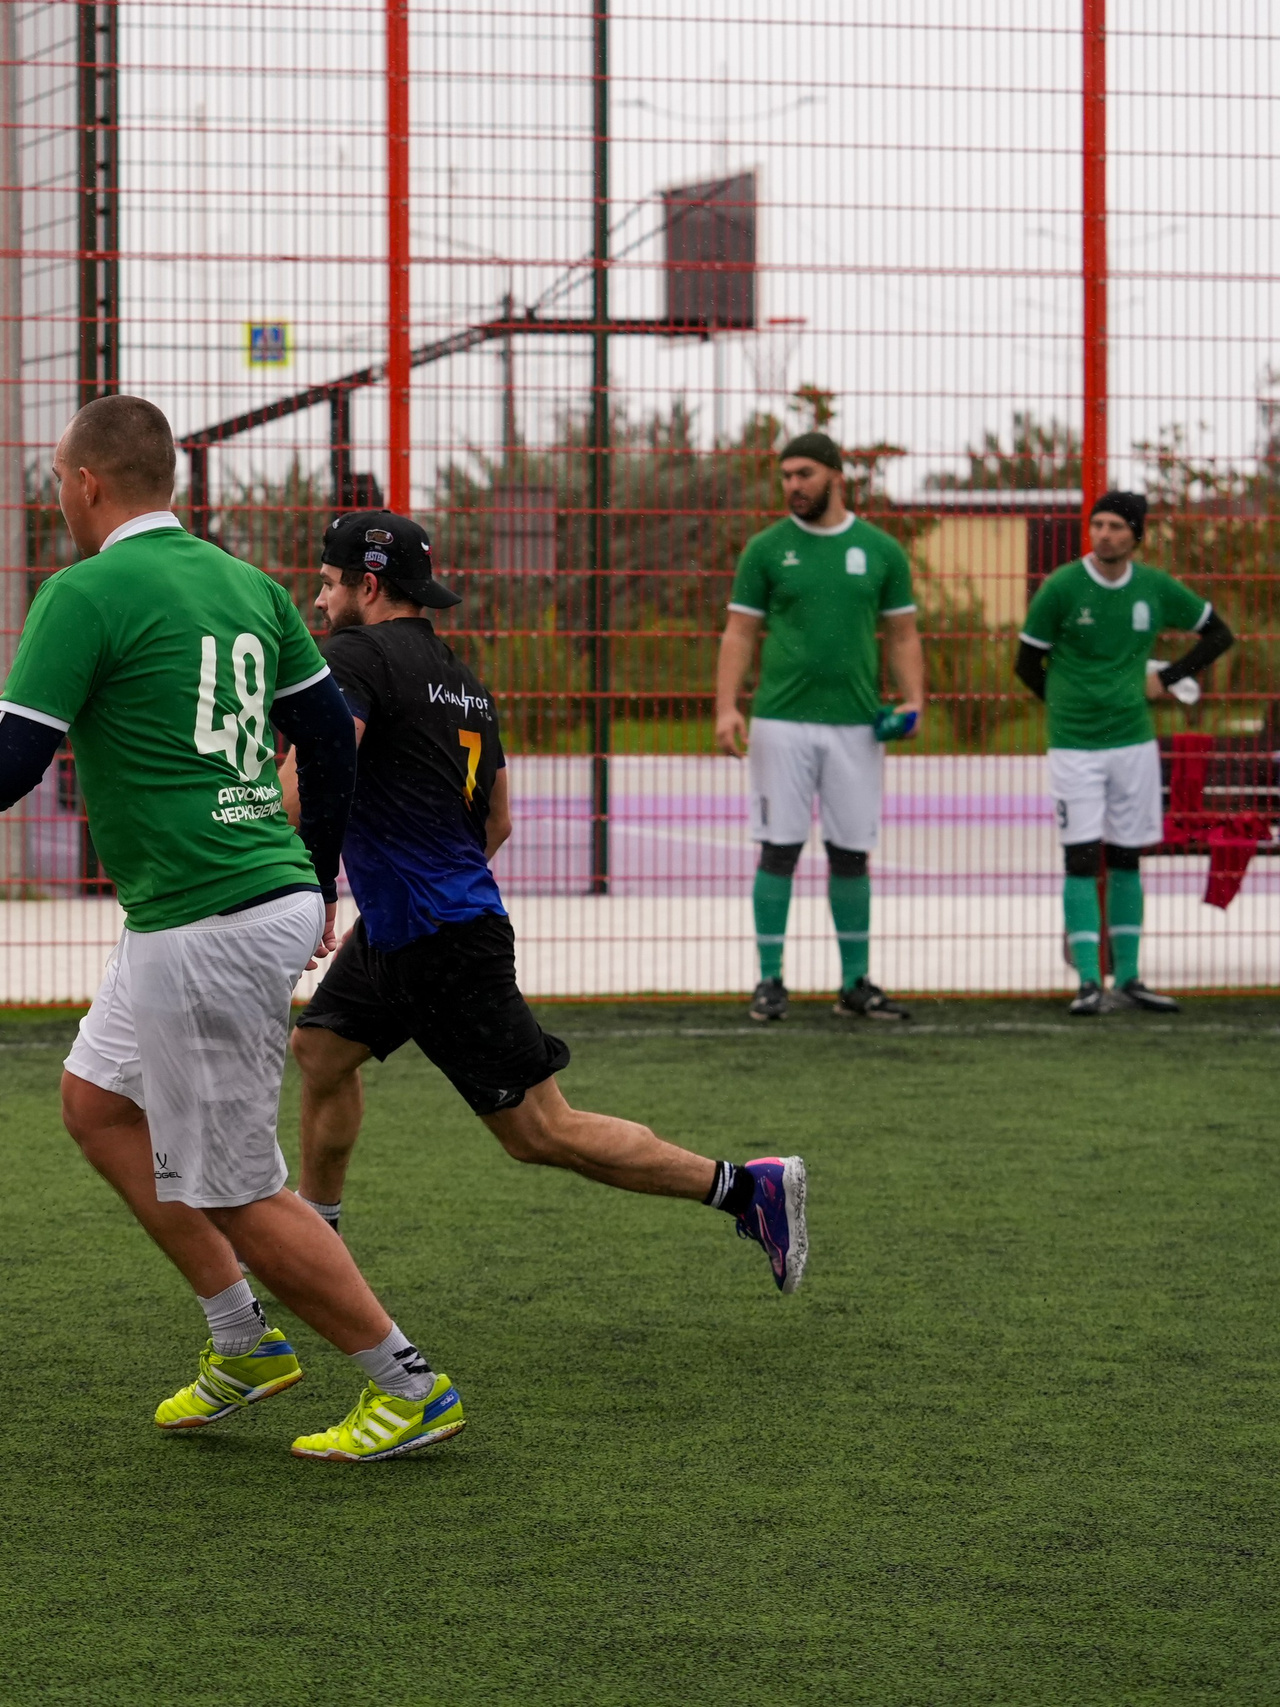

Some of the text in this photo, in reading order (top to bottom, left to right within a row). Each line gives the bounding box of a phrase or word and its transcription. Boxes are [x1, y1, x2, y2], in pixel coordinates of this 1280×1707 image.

[194, 632, 276, 782] 48
[458, 728, 482, 811] 7
[153, 1170, 183, 1179] ÖGEL
